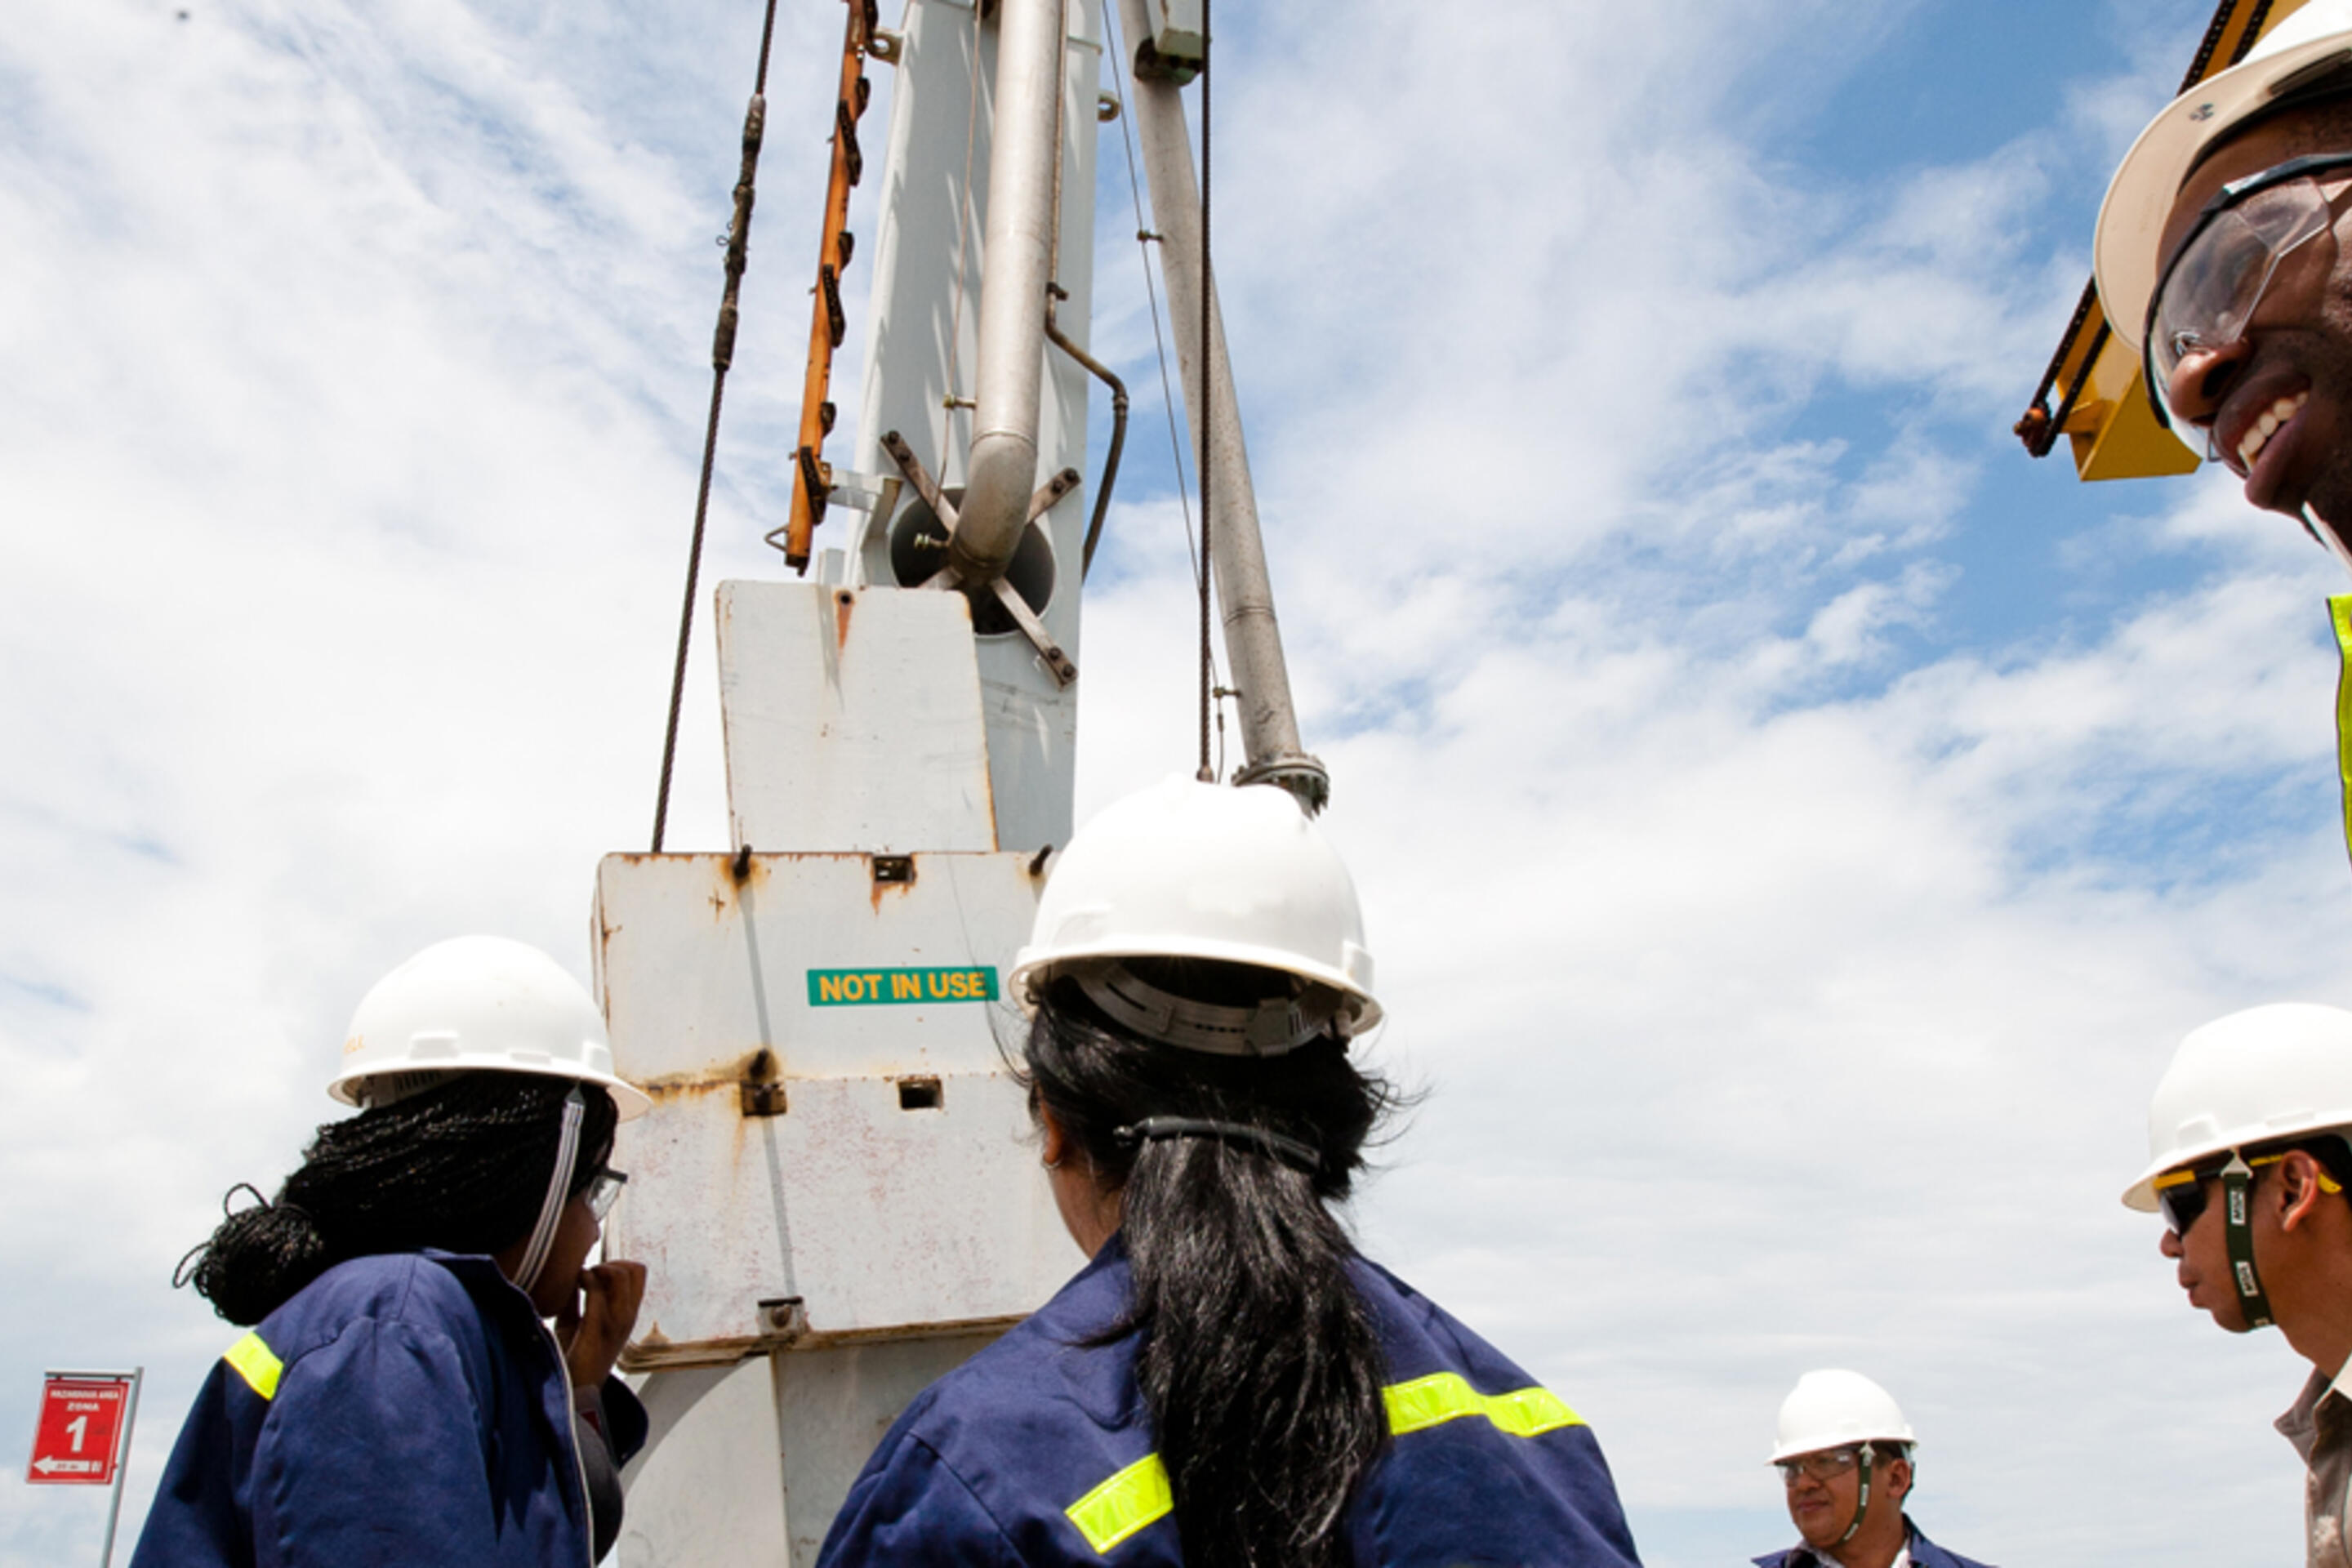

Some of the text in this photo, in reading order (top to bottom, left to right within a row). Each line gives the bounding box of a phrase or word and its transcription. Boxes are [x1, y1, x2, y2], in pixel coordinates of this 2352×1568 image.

[819, 972, 987, 1001] NOT IN USE
[66, 1415, 87, 1453] 1
